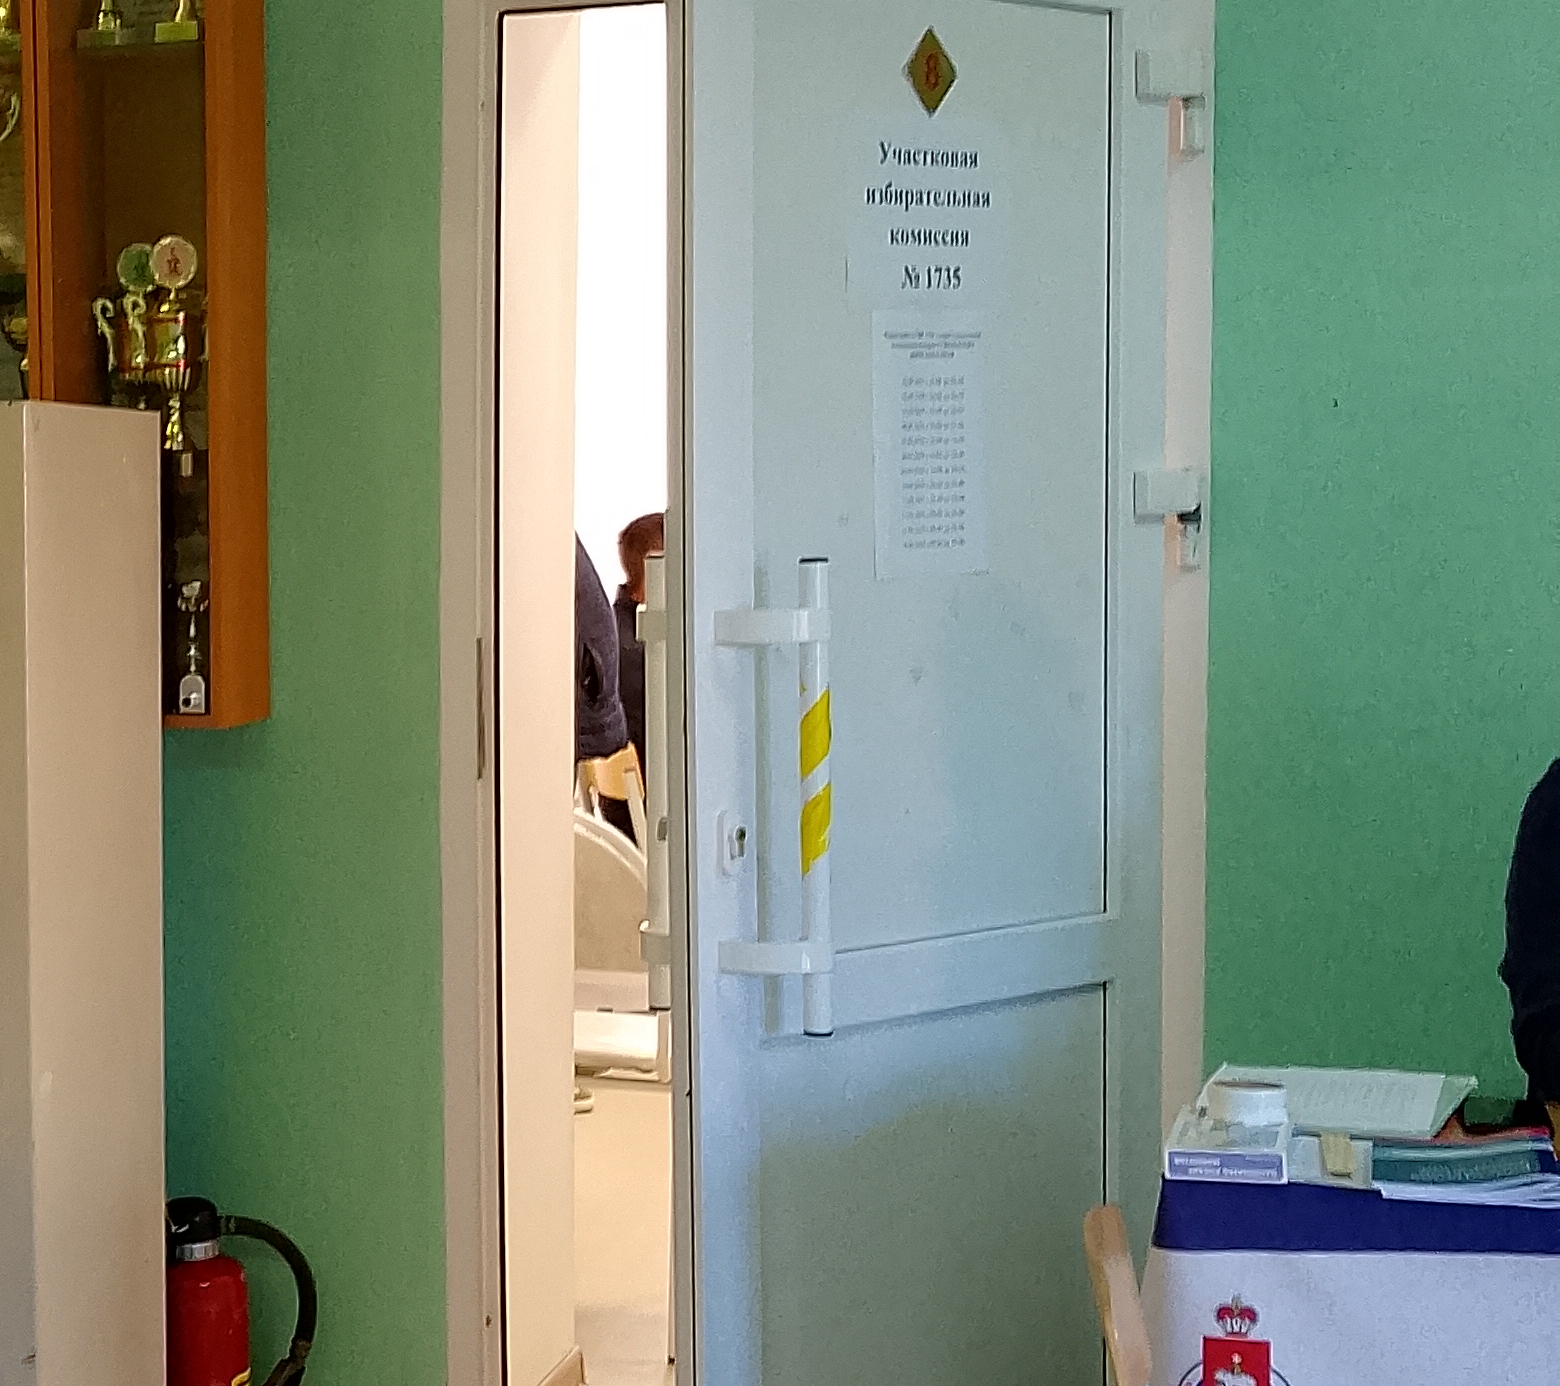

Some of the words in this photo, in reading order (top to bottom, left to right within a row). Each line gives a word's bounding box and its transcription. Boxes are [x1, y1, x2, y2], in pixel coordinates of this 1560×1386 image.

[877, 140, 979, 169] Участковая
[865, 180, 991, 212] избирательная
[889, 227, 970, 247] комиссия
[901, 264, 922, 290] №
[926, 265, 962, 290] 1735
